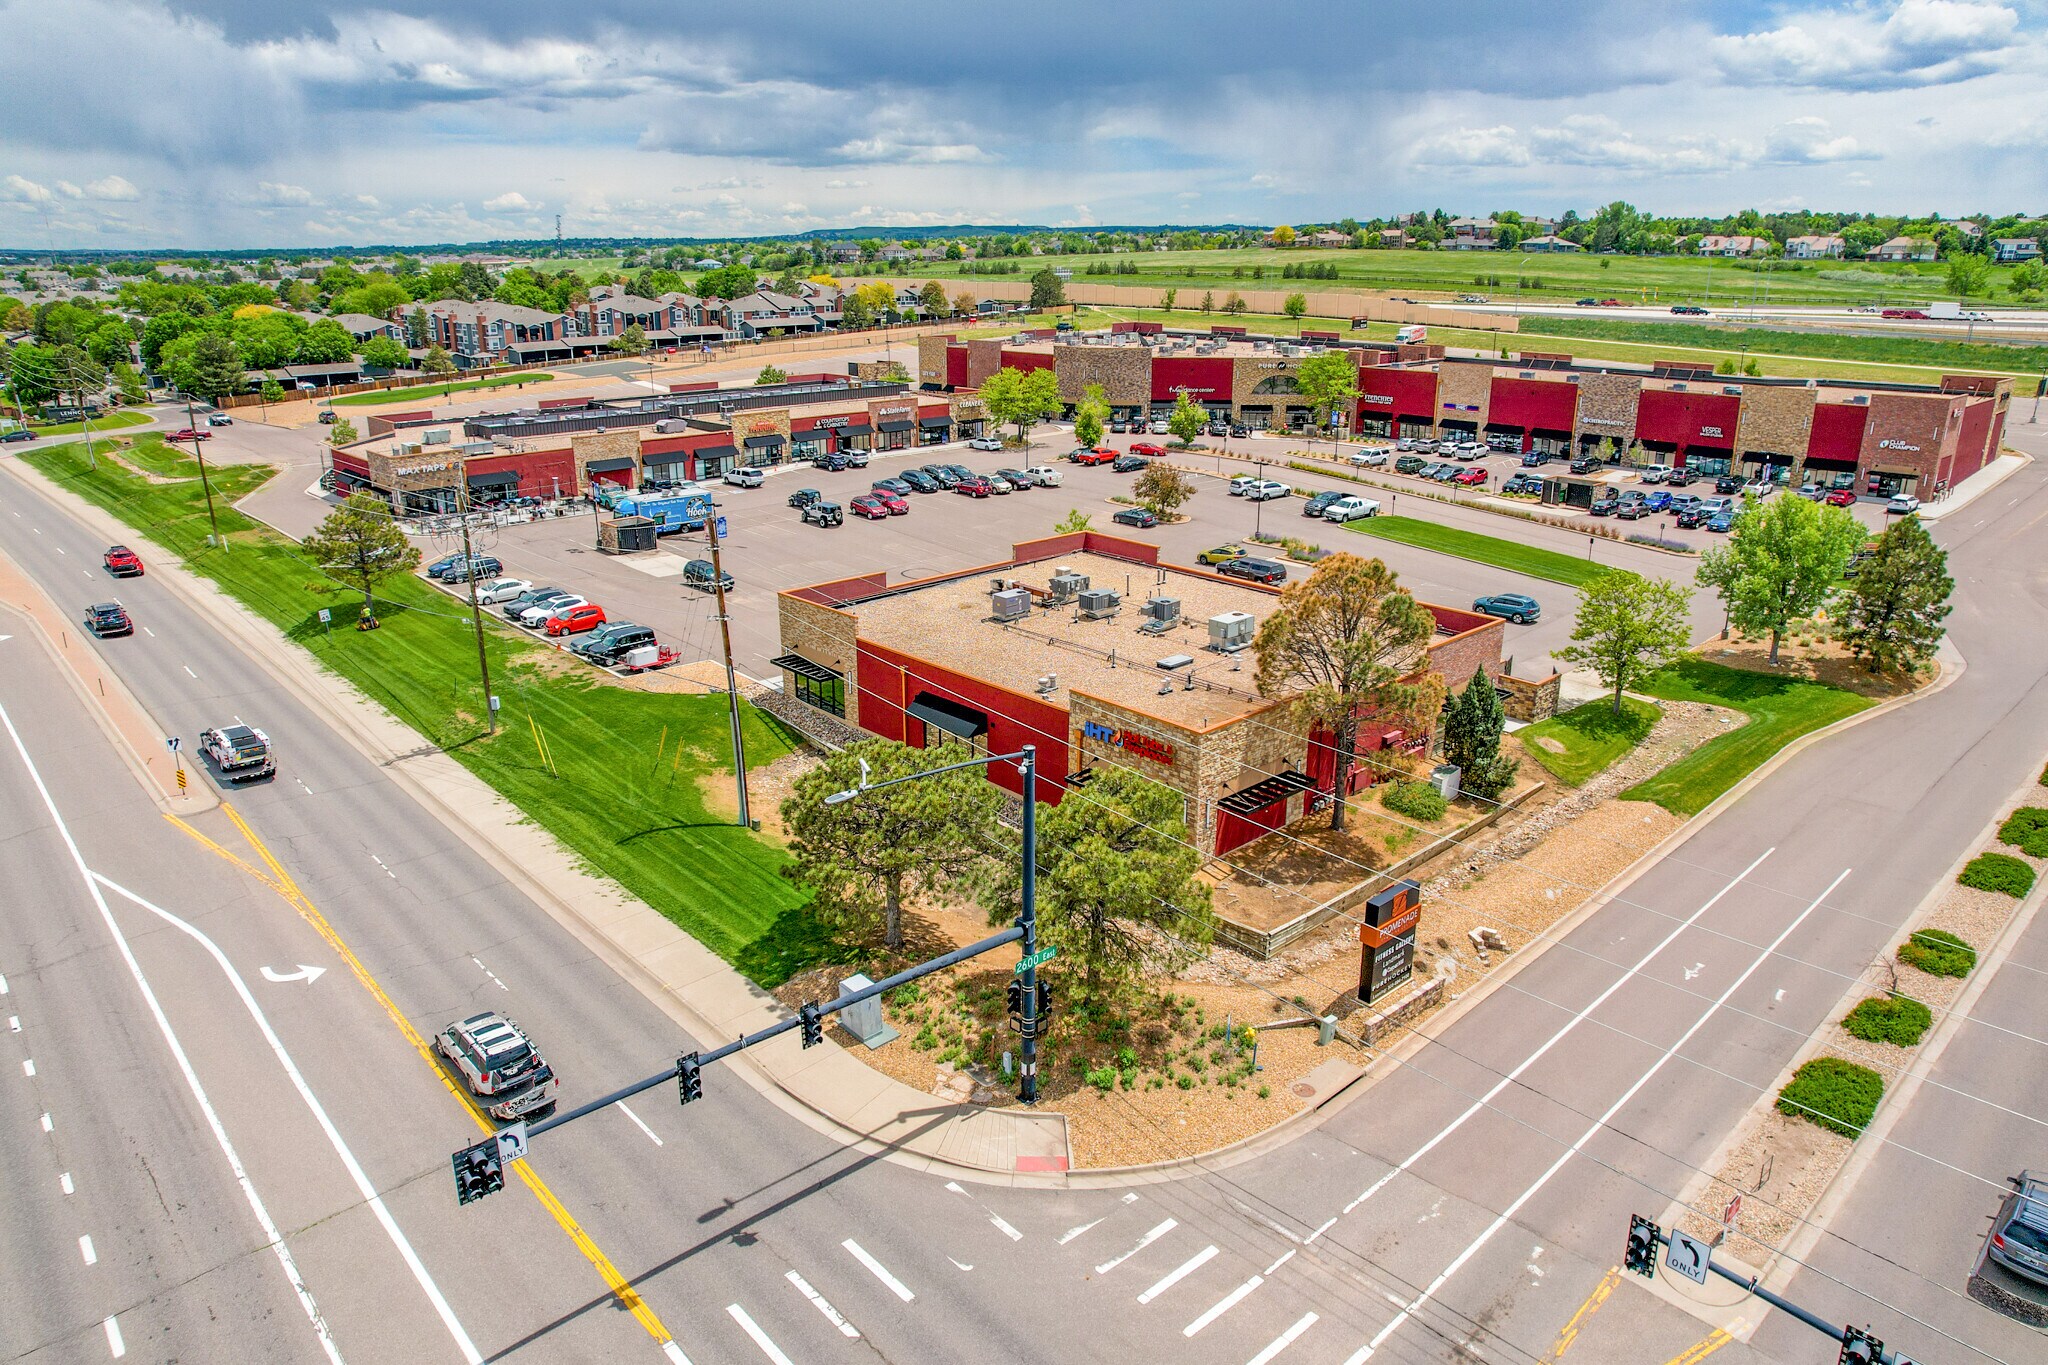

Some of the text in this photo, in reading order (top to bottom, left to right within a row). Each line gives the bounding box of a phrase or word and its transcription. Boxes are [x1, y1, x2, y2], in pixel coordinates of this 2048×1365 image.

[959, 400, 984, 408] CLEANERS
[821, 416, 850, 424] COUNTERTOPS
[1588, 418, 1626, 427] CHIROPRACTIC
[1701, 426, 1722, 434] VESPER
[1888, 444, 1921, 452] CHAMPION
[397, 463, 446, 476] MAX TAPS
[1085, 721, 1113, 744] iHT
[1379, 908, 1419, 939] PROMENADE
[1016, 948, 1056, 974] 2600 East
[1374, 946, 1395, 964] FITNESS
[1382, 948, 1405, 968] Landmark
[500, 1146, 525, 1163] ONLY
[1671, 1258, 1701, 1278] ONLY
